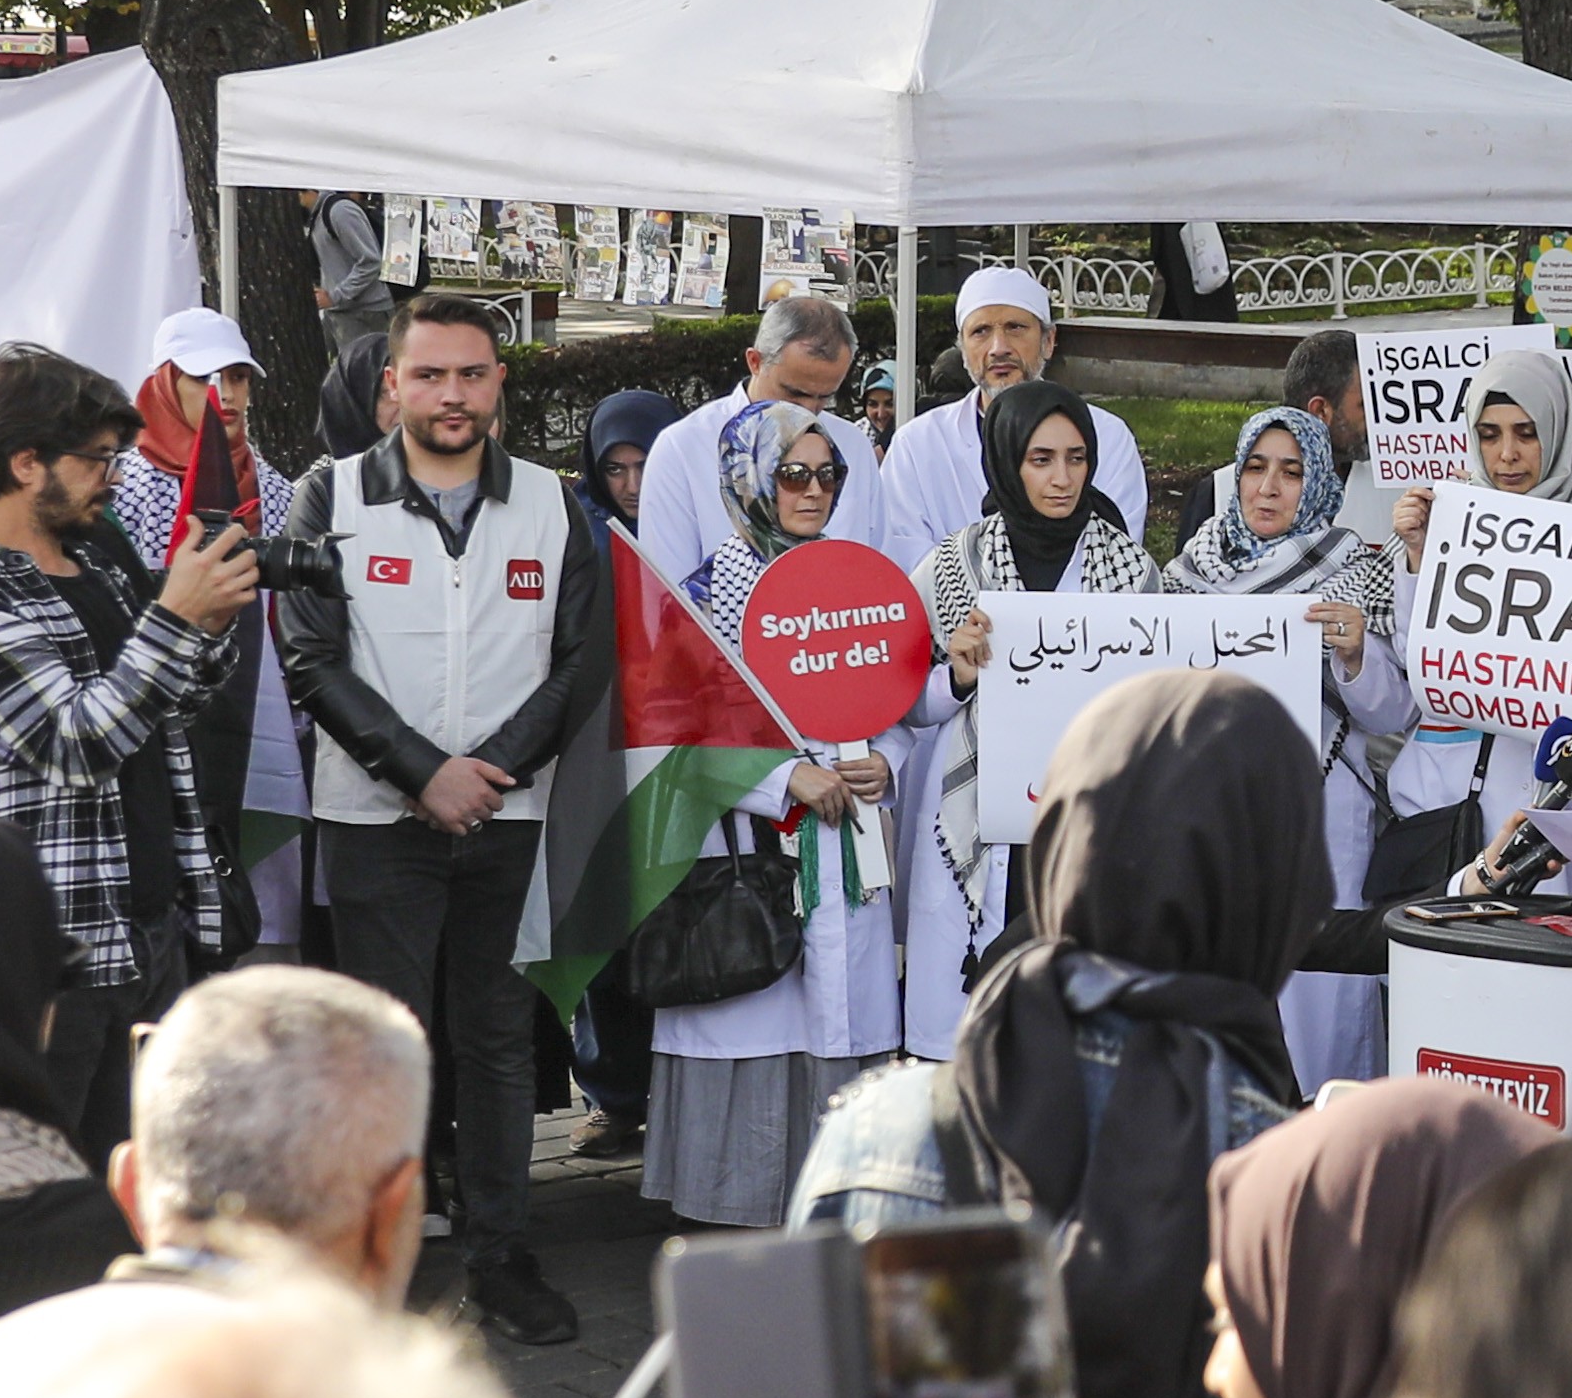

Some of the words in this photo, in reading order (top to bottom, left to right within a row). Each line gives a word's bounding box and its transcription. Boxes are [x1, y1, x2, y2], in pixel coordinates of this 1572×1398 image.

[1367, 369, 1473, 424] İSRA
[1378, 433, 1468, 455] HASTAN
[1381, 460, 1468, 482] BOMBA
[509, 571, 543, 589] AID
[760, 602, 906, 641] Soykırıma
[789, 649, 838, 675] dur
[845, 640, 890, 667] de!
[1009, 615, 1171, 685] الاسرائيلي
[1188, 615, 1288, 670] المحتل
